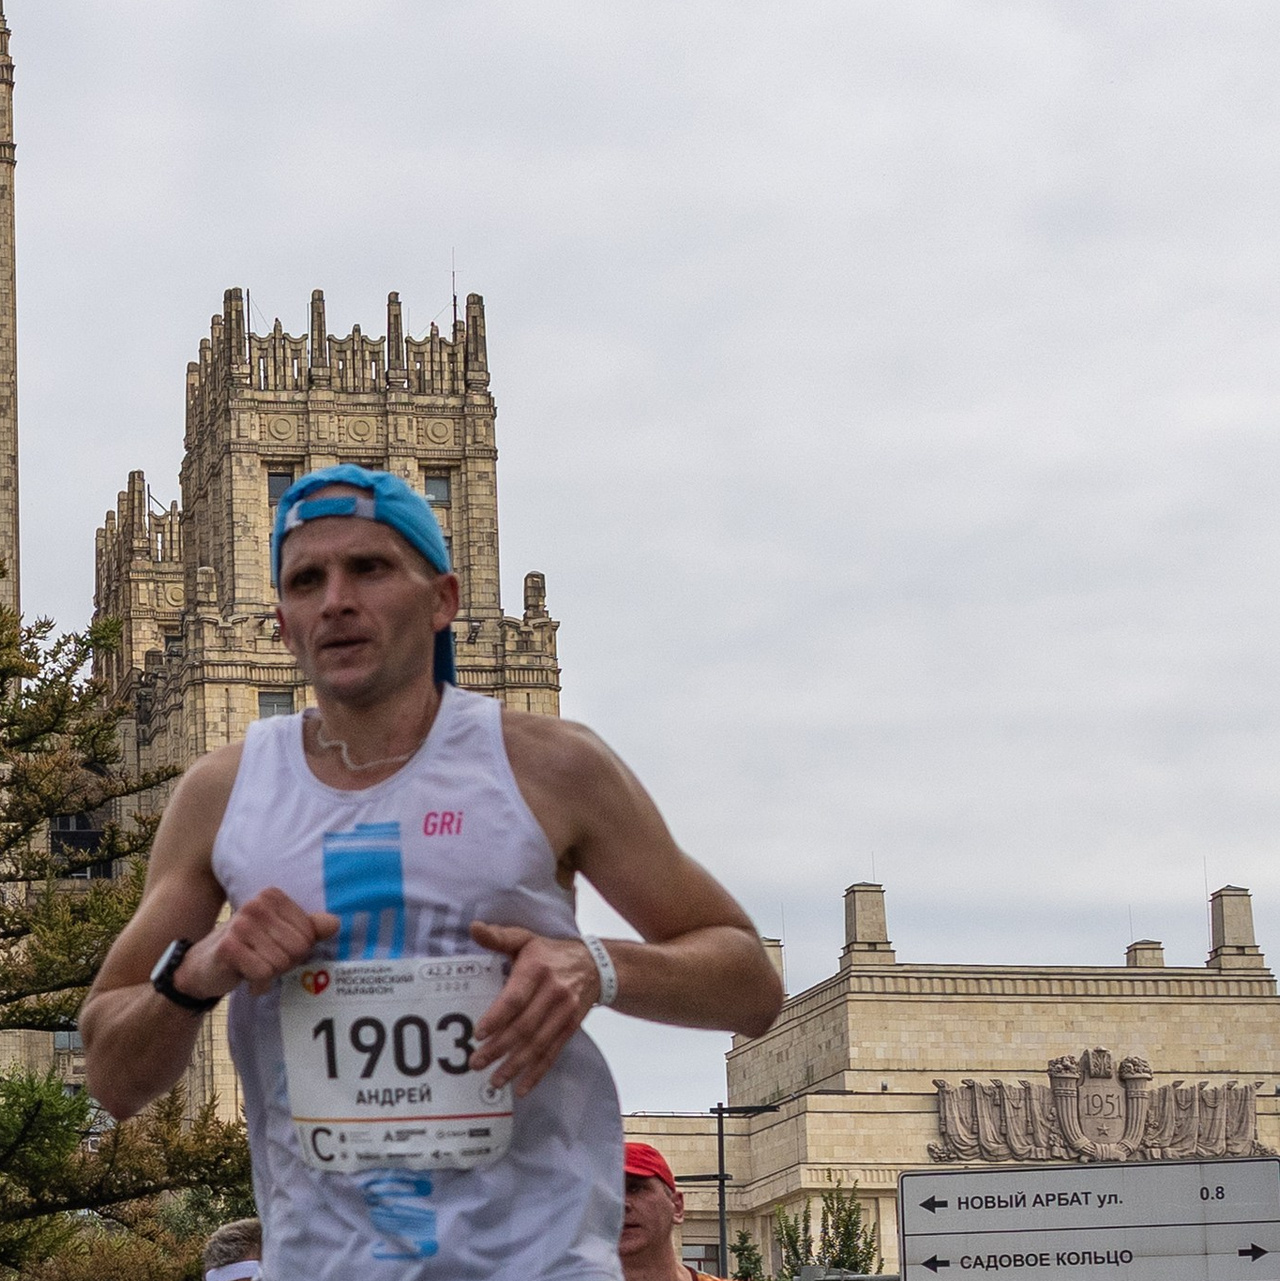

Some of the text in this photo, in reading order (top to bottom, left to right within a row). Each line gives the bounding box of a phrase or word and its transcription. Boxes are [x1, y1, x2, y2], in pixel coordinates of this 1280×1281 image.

[312, 1012, 474, 1080] 1903
[356, 1083, 432, 1107] АНДРЕЙ
[957, 1186, 1225, 1210] НОВЫЙ АРБАТ ул. 0.8
[960, 1249, 1133, 1271] САДОВОЕ КОЛЬЦО
